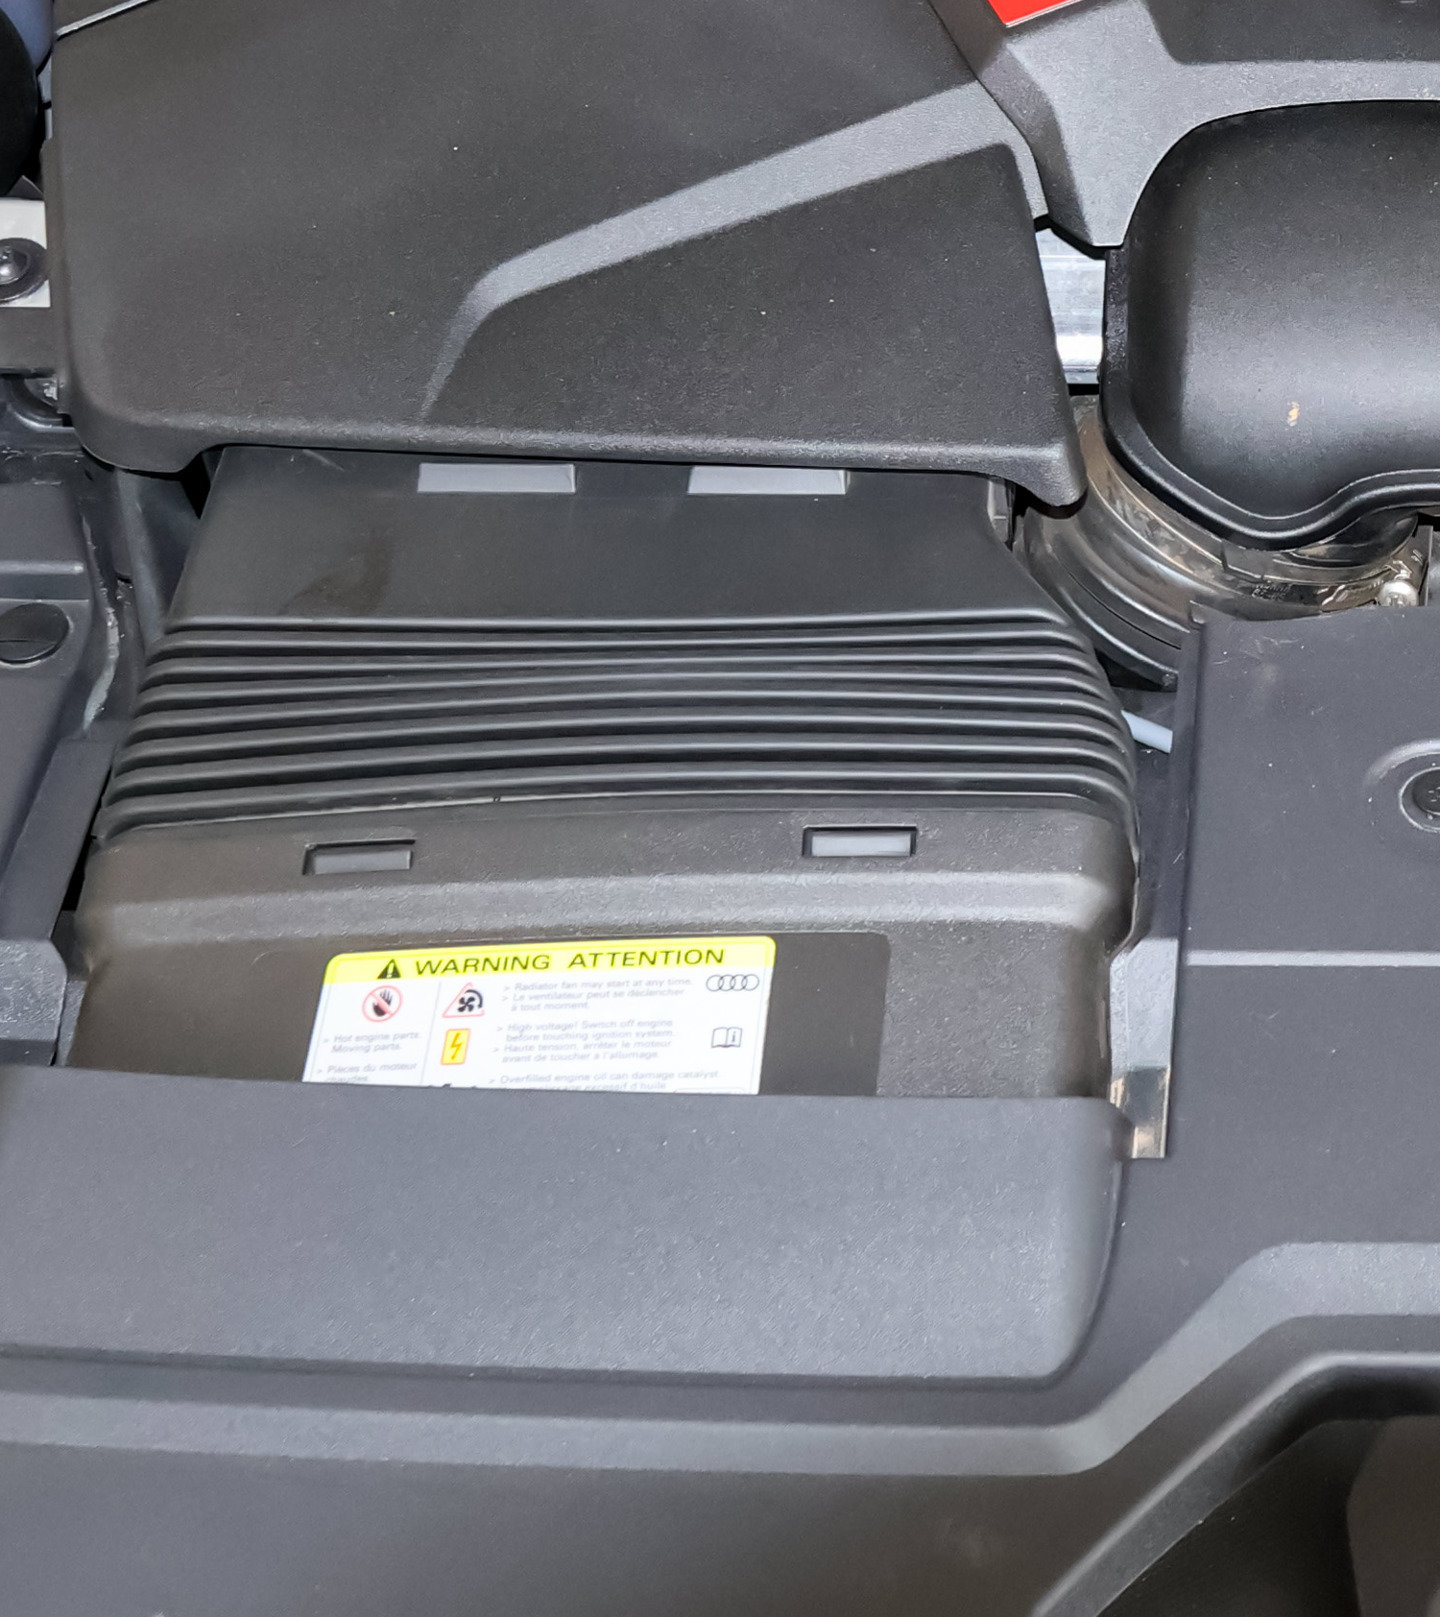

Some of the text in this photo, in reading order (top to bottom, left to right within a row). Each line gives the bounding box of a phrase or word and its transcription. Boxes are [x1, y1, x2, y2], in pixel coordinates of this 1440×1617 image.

[414, 948, 726, 975] WARNING ATTENTION
[514, 982, 558, 992] Radiator
[561, 981, 578, 989] fan
[581, 982, 603, 991] may
[607, 980, 630, 988] start
[645, 979, 664, 988] any
[512, 993, 525, 1002] Le
[529, 991, 583, 1001] ventilateur
[586, 990, 610, 1001] peut
[612, 990, 624, 998] se
[520, 1003, 541, 1012] tout
[544, 1001, 590, 1011] moment.
[507, 1019, 673, 1034] High voltage! Switch off engine
[334, 1034, 353, 1042] Hot
[355, 1034, 390, 1043] engine
[506, 1032, 540, 1042] before
[542, 1031, 588, 1042] touching
[592, 1031, 632, 1041] ignition
[331, 1045, 371, 1053] Moving
[504, 1044, 535, 1053] Haute
[621, 1040, 631, 1049] le
[633, 1040, 672, 1049] moteur
[502, 1054, 531, 1063] avant
[534, 1053, 547, 1063] de
[550, 1052, 591, 1062] toucher
[363, 1064, 375, 1072] du
[380, 1063, 417, 1071] moteur
[500, 1074, 552, 1085] Overfilled
[554, 1074, 593, 1083] engine
[593, 1072, 608, 1081] oil
[610, 1072, 628, 1081] can
[631, 1071, 675, 1081] damage
